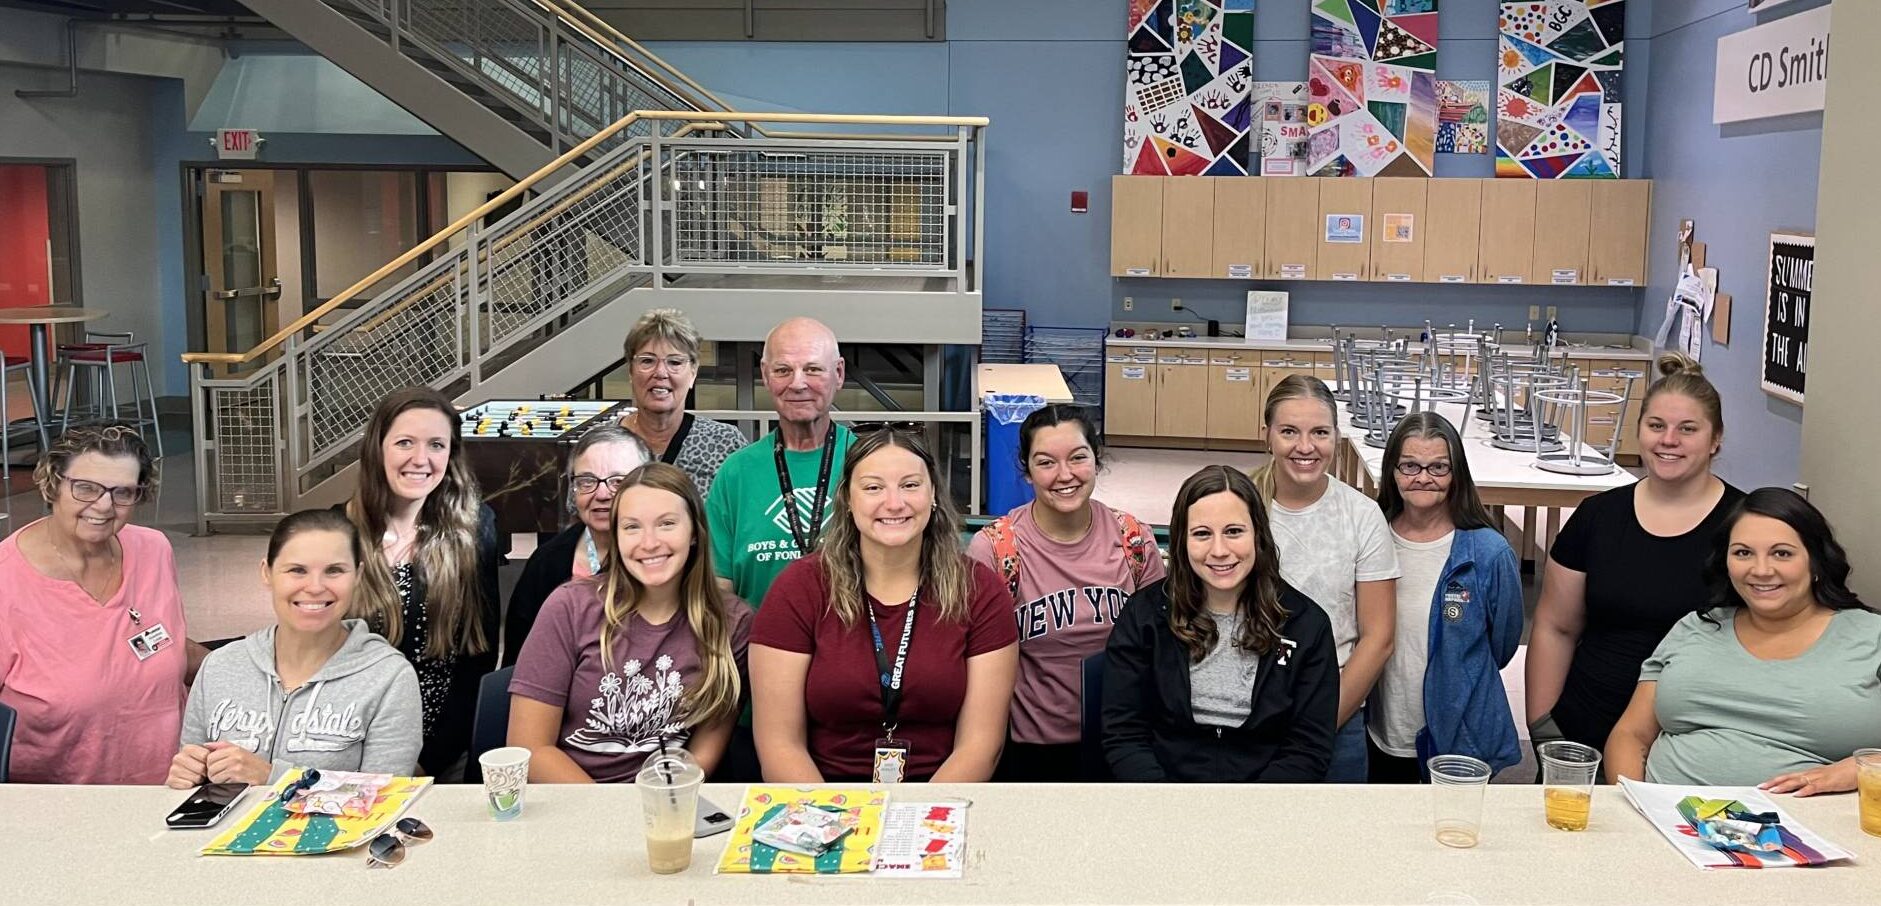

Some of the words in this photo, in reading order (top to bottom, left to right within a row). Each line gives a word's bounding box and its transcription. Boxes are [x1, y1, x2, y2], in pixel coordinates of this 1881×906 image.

[1549, 5, 1572, 31] BGC
[1748, 53, 1773, 93] CD
[224, 131, 249, 151] EXIT
[1280, 126, 1310, 138] SMA
[1775, 254, 1814, 292] SUMME
[1777, 291, 1789, 323] IS
[1794, 296, 1806, 328] IN
[1771, 332, 1790, 367] THE
[747, 540, 776, 552] BOYS
[779, 539, 789, 549] &
[756, 552, 772, 562] OF
[897, 609, 915, 655] FUTURES
[1014, 587, 1077, 643] NEW
[1083, 586, 1131, 625] YO
[890, 655, 905, 690] GREAT
